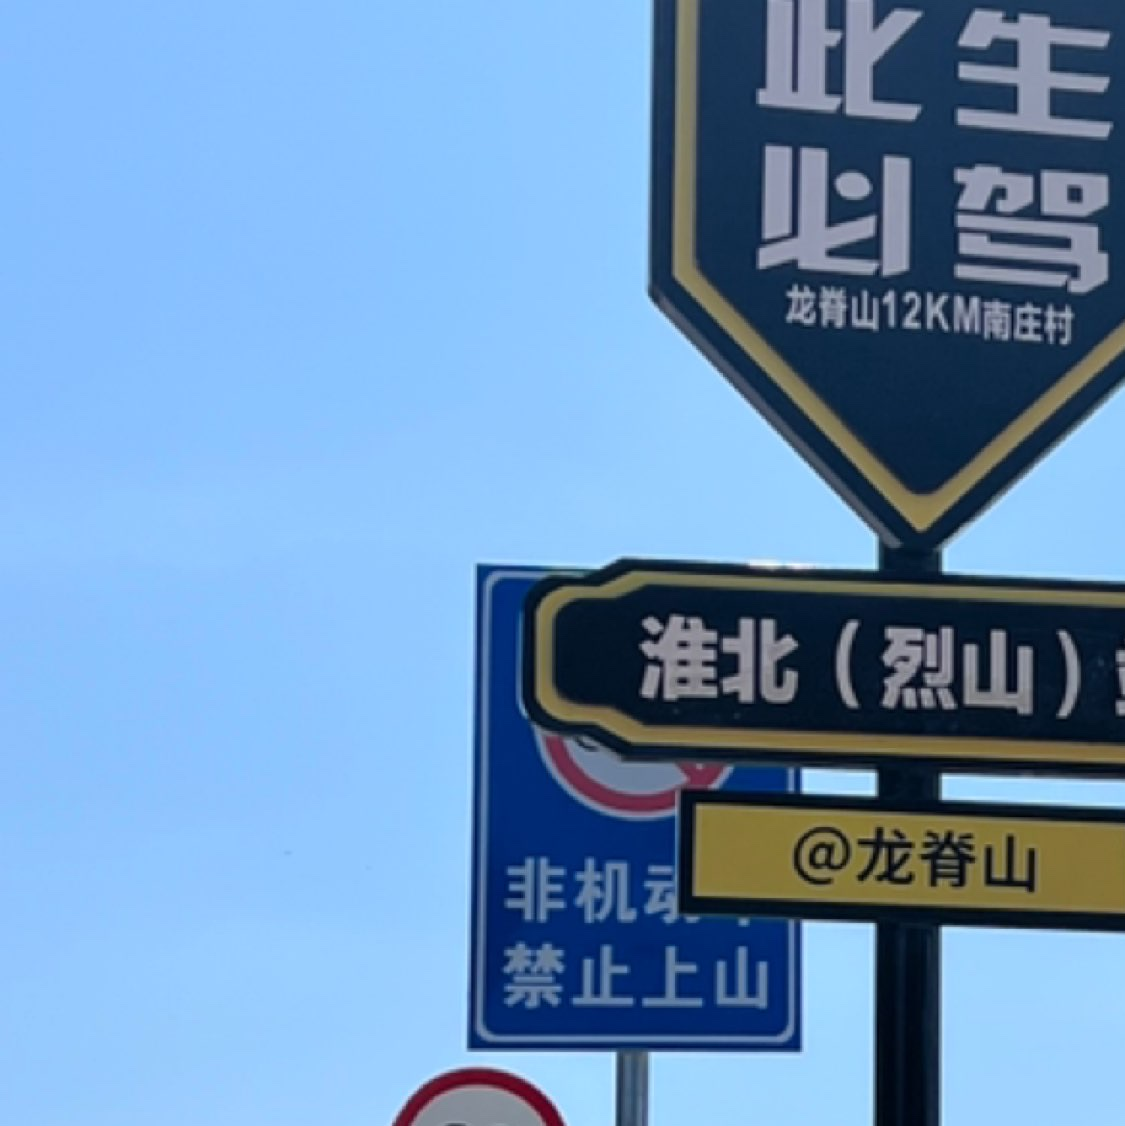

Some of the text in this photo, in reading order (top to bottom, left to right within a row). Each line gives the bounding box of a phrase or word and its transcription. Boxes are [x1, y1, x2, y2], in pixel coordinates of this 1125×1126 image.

[756, 0, 1114, 138] 此生
[756, 145, 1109, 294] 必驾
[785, 284, 1074, 345] 龙脊山12KM南庄村
[793, 827, 1037, 892] @龙脊山
[503, 942, 768, 1009] 禁止上山
